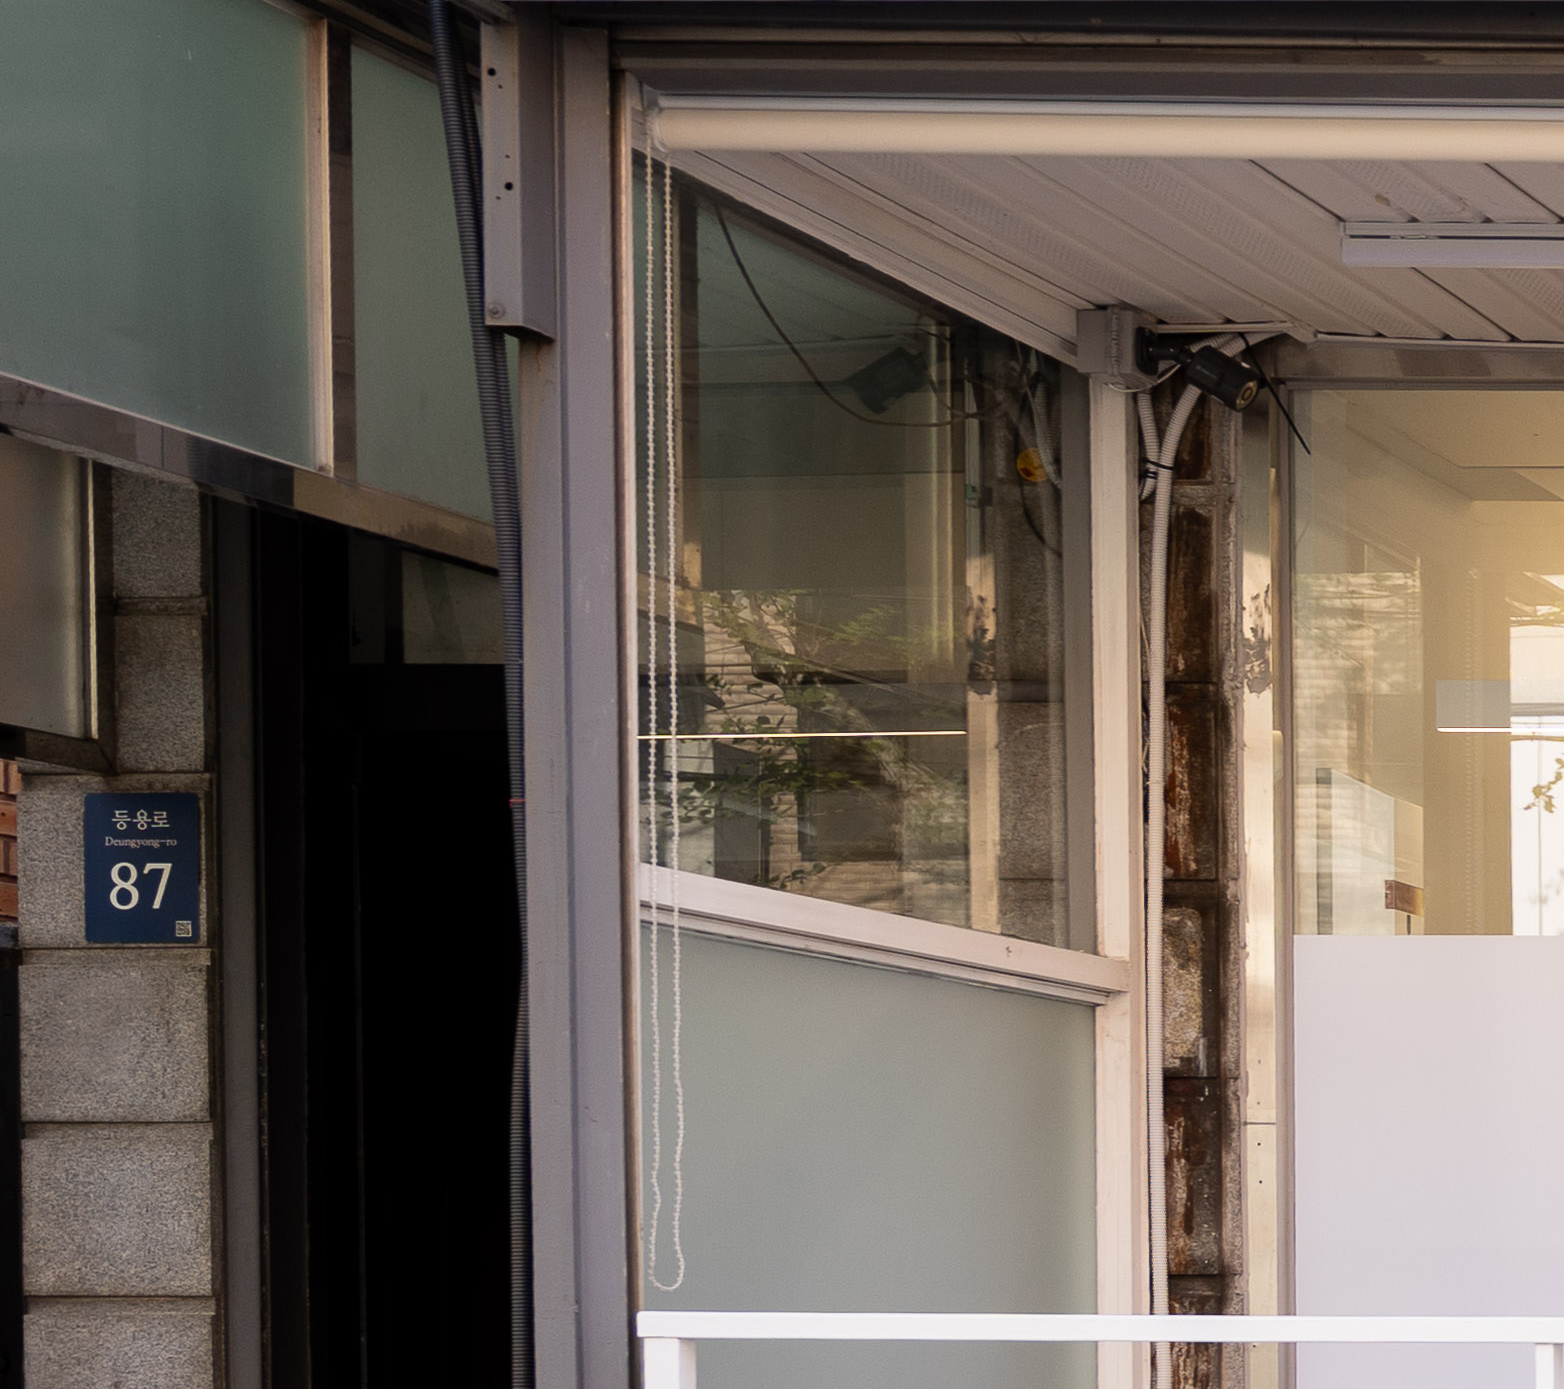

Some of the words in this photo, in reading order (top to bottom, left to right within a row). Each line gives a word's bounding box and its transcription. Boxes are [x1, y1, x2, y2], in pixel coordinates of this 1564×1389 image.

[111, 809, 171, 831] 등용로
[105, 836, 178, 849] Deungyong-ro
[109, 861, 172, 911] 87
